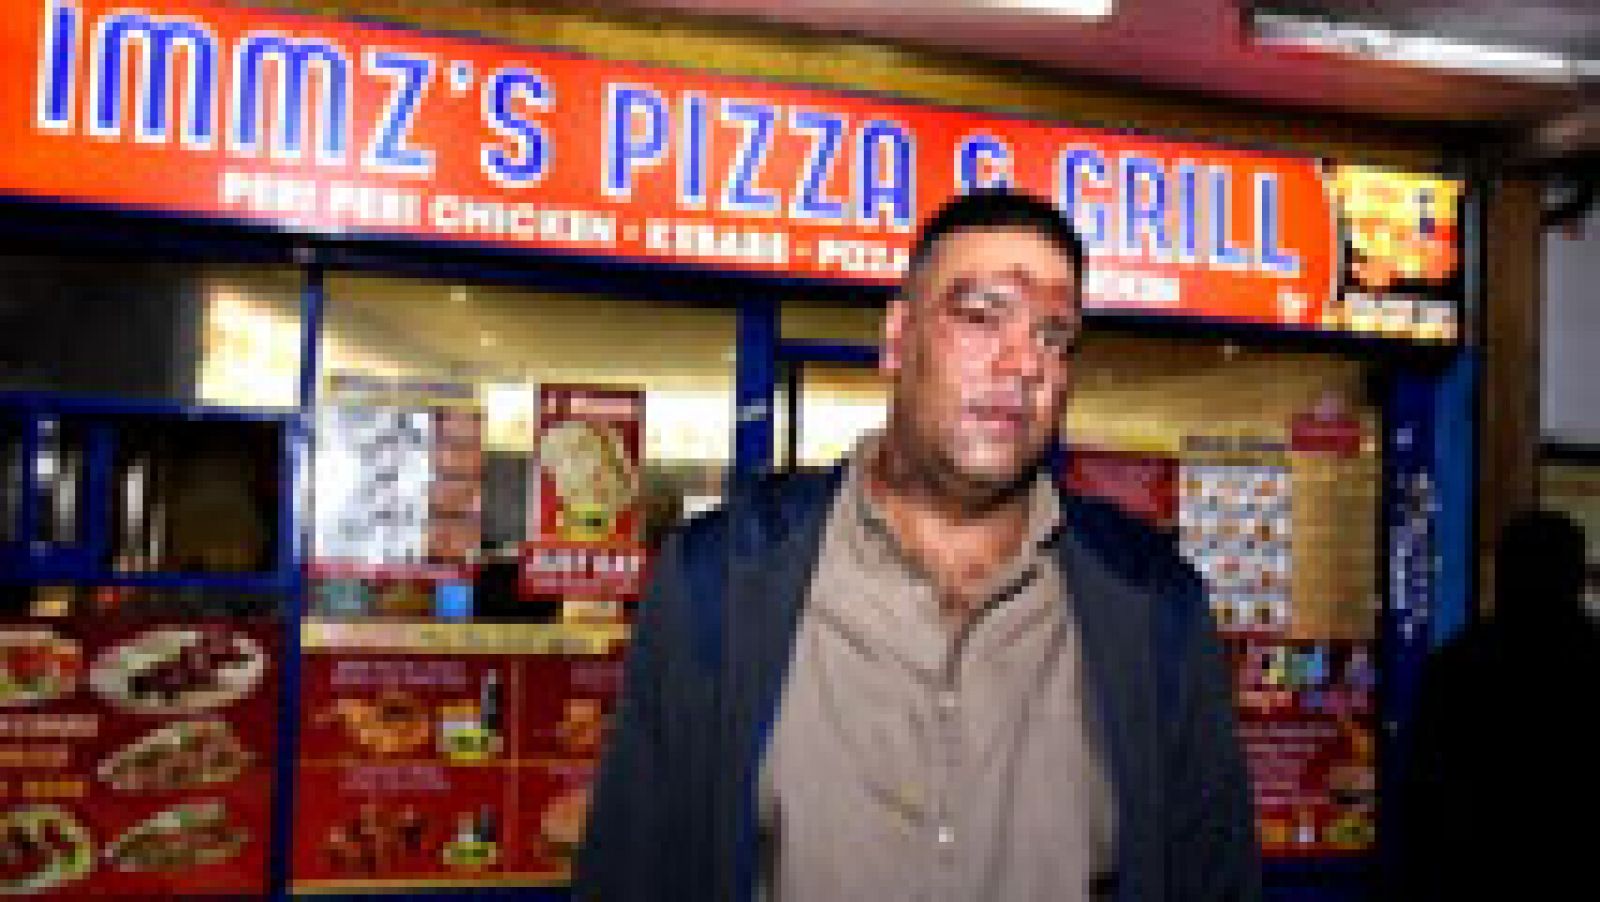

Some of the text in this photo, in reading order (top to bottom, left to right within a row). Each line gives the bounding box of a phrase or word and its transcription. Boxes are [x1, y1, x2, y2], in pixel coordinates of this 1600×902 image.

[38, 0, 556, 187] IMMZ'S
[601, 83, 917, 232] PIZZA
[1059, 142, 1300, 277] GRILL
[430, 194, 617, 243] CHICKEN
